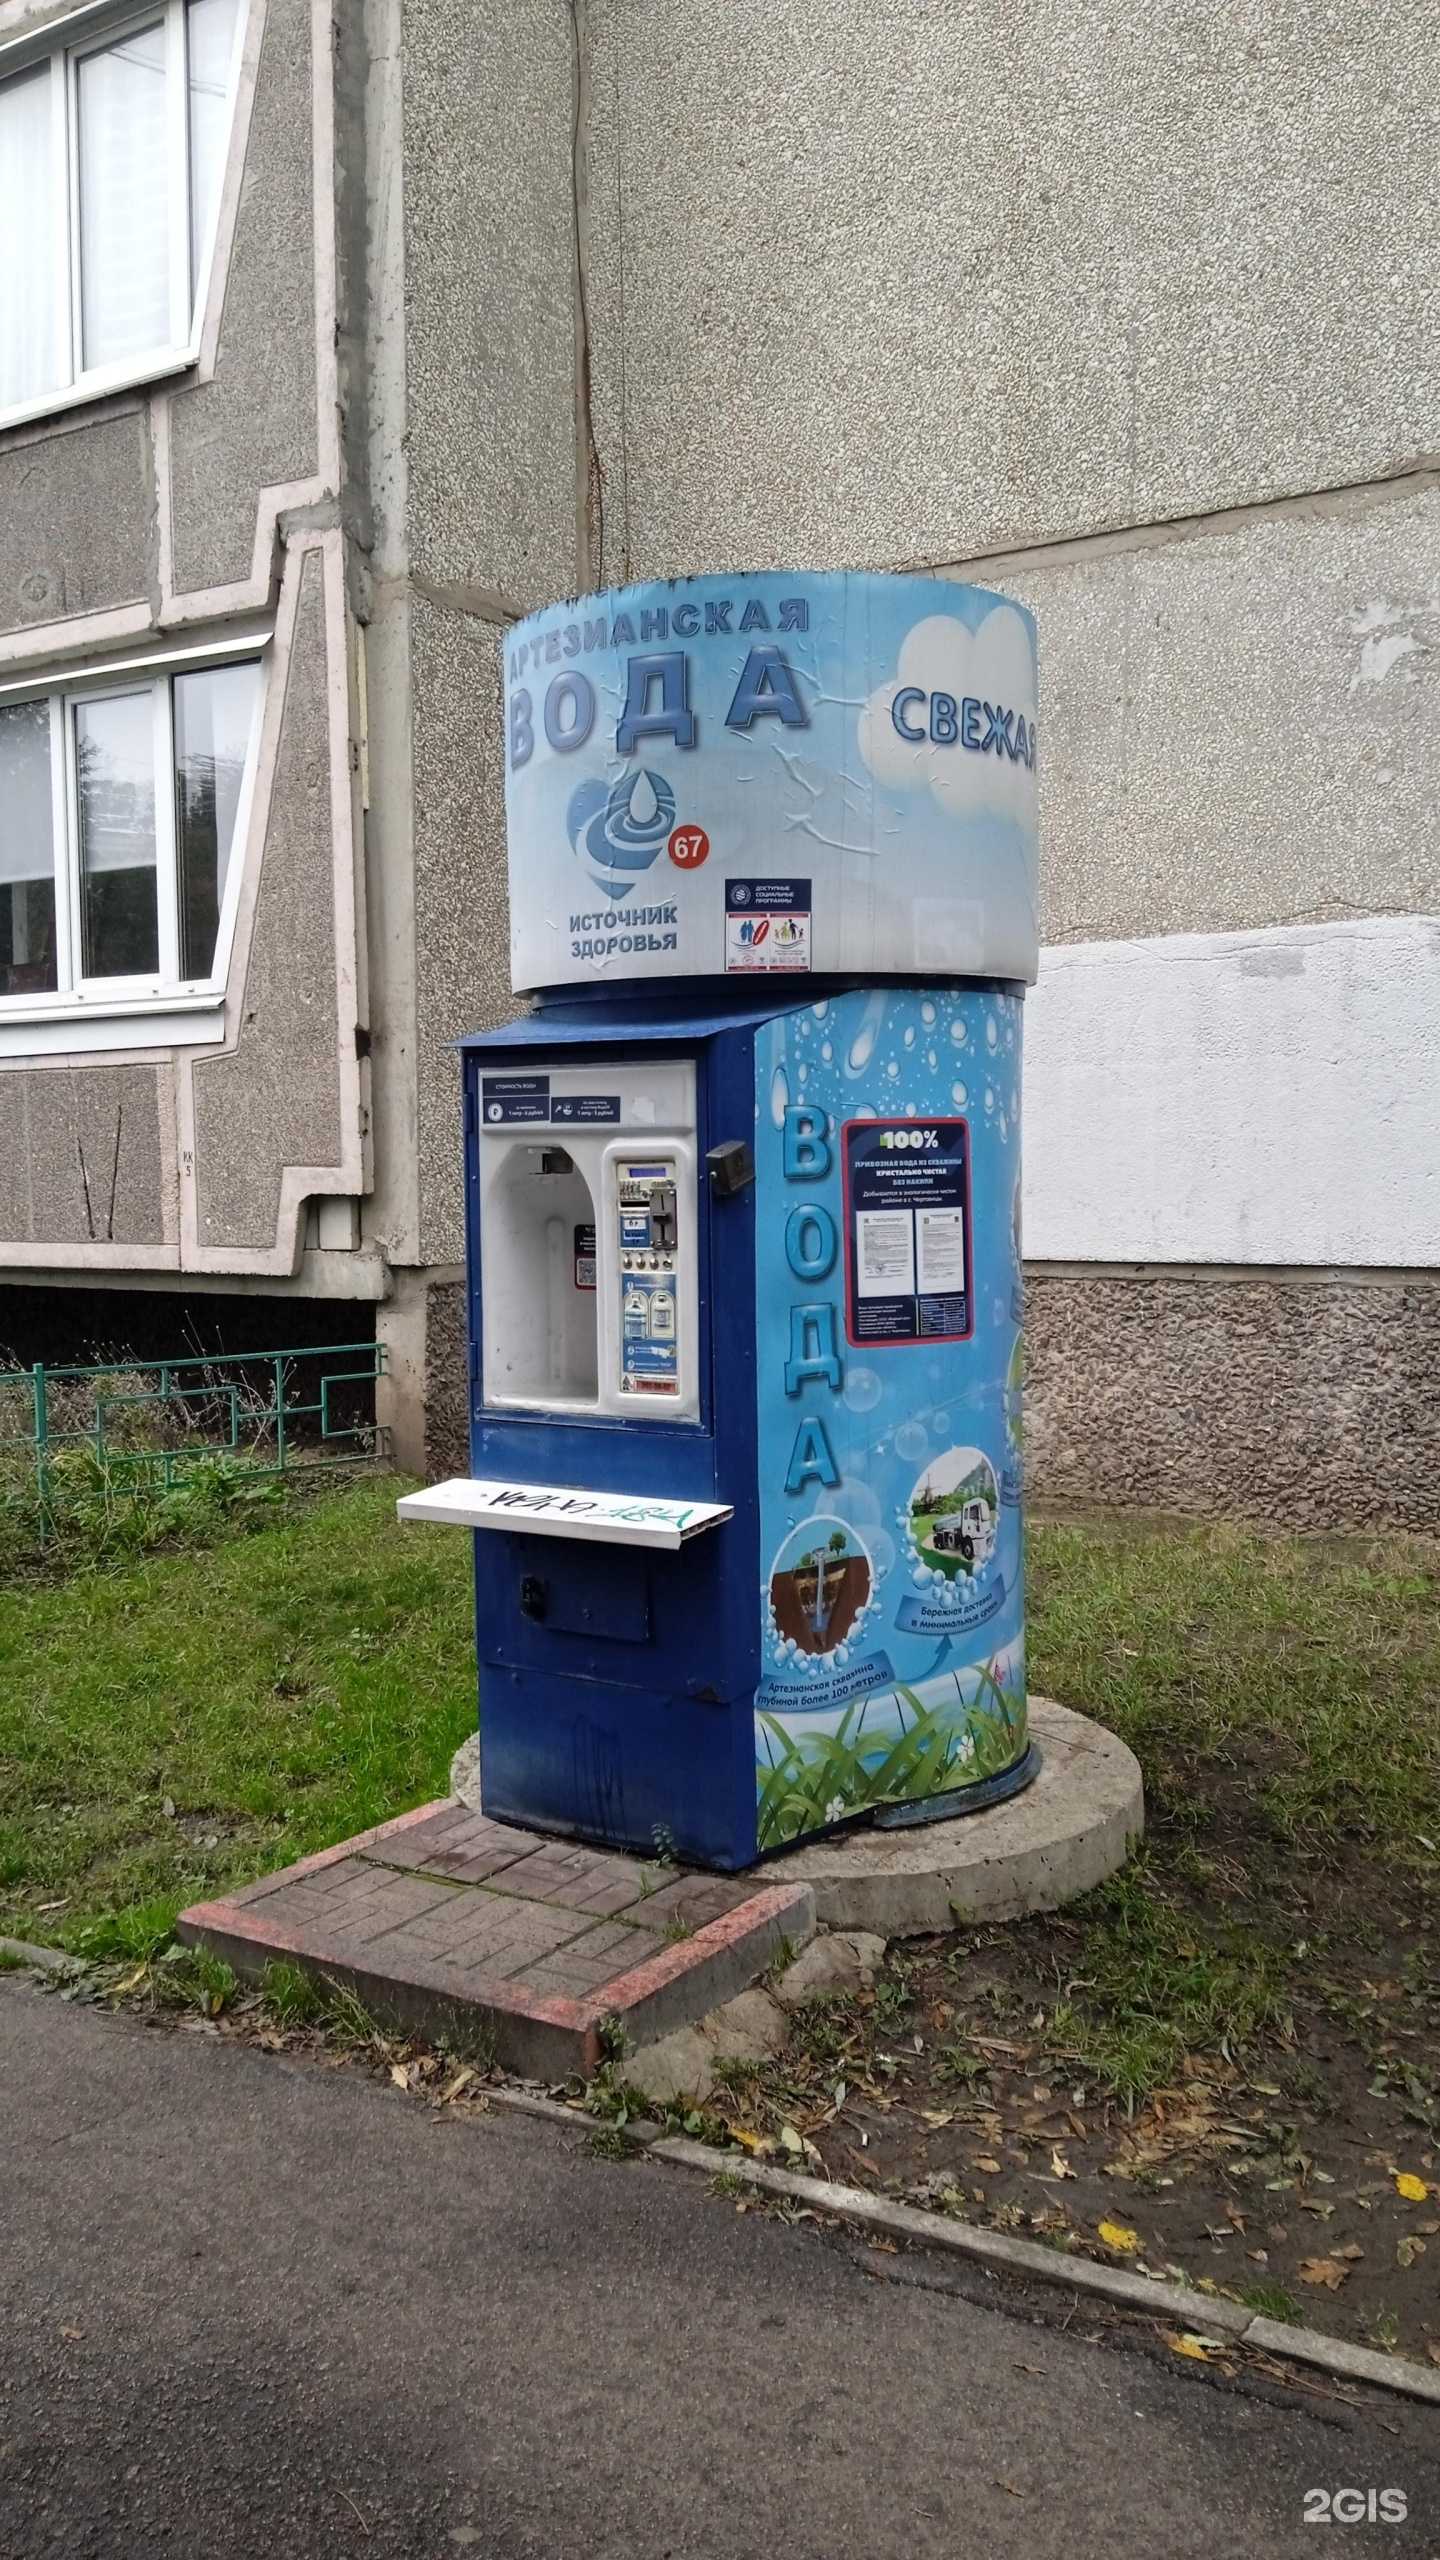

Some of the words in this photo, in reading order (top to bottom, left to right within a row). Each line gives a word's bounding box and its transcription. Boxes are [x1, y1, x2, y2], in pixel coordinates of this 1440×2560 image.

[509, 598, 809, 685] АРТЕЗИАНСКАЯ
[510, 644, 811, 772] ВОДА
[674, 835, 703, 859] 67
[569, 905, 678, 933] ИСТОЧНИК
[571, 932, 678, 960] ЗДОРОВЬЯ
[882, 1130, 939, 1149] 100%
[855, 1160, 898, 1168] ПРИВОЗНАЯ
[784, 1104, 843, 1496] ВОДА
[919, 1614, 979, 1629] минимальные
[921, 1606, 962, 1618] Бережная
[768, 1681, 831, 1695] Артезианская
[831, 1663, 875, 1686] скважина
[801, 1693, 829, 1706] более
[832, 1686, 849, 1699] 100
